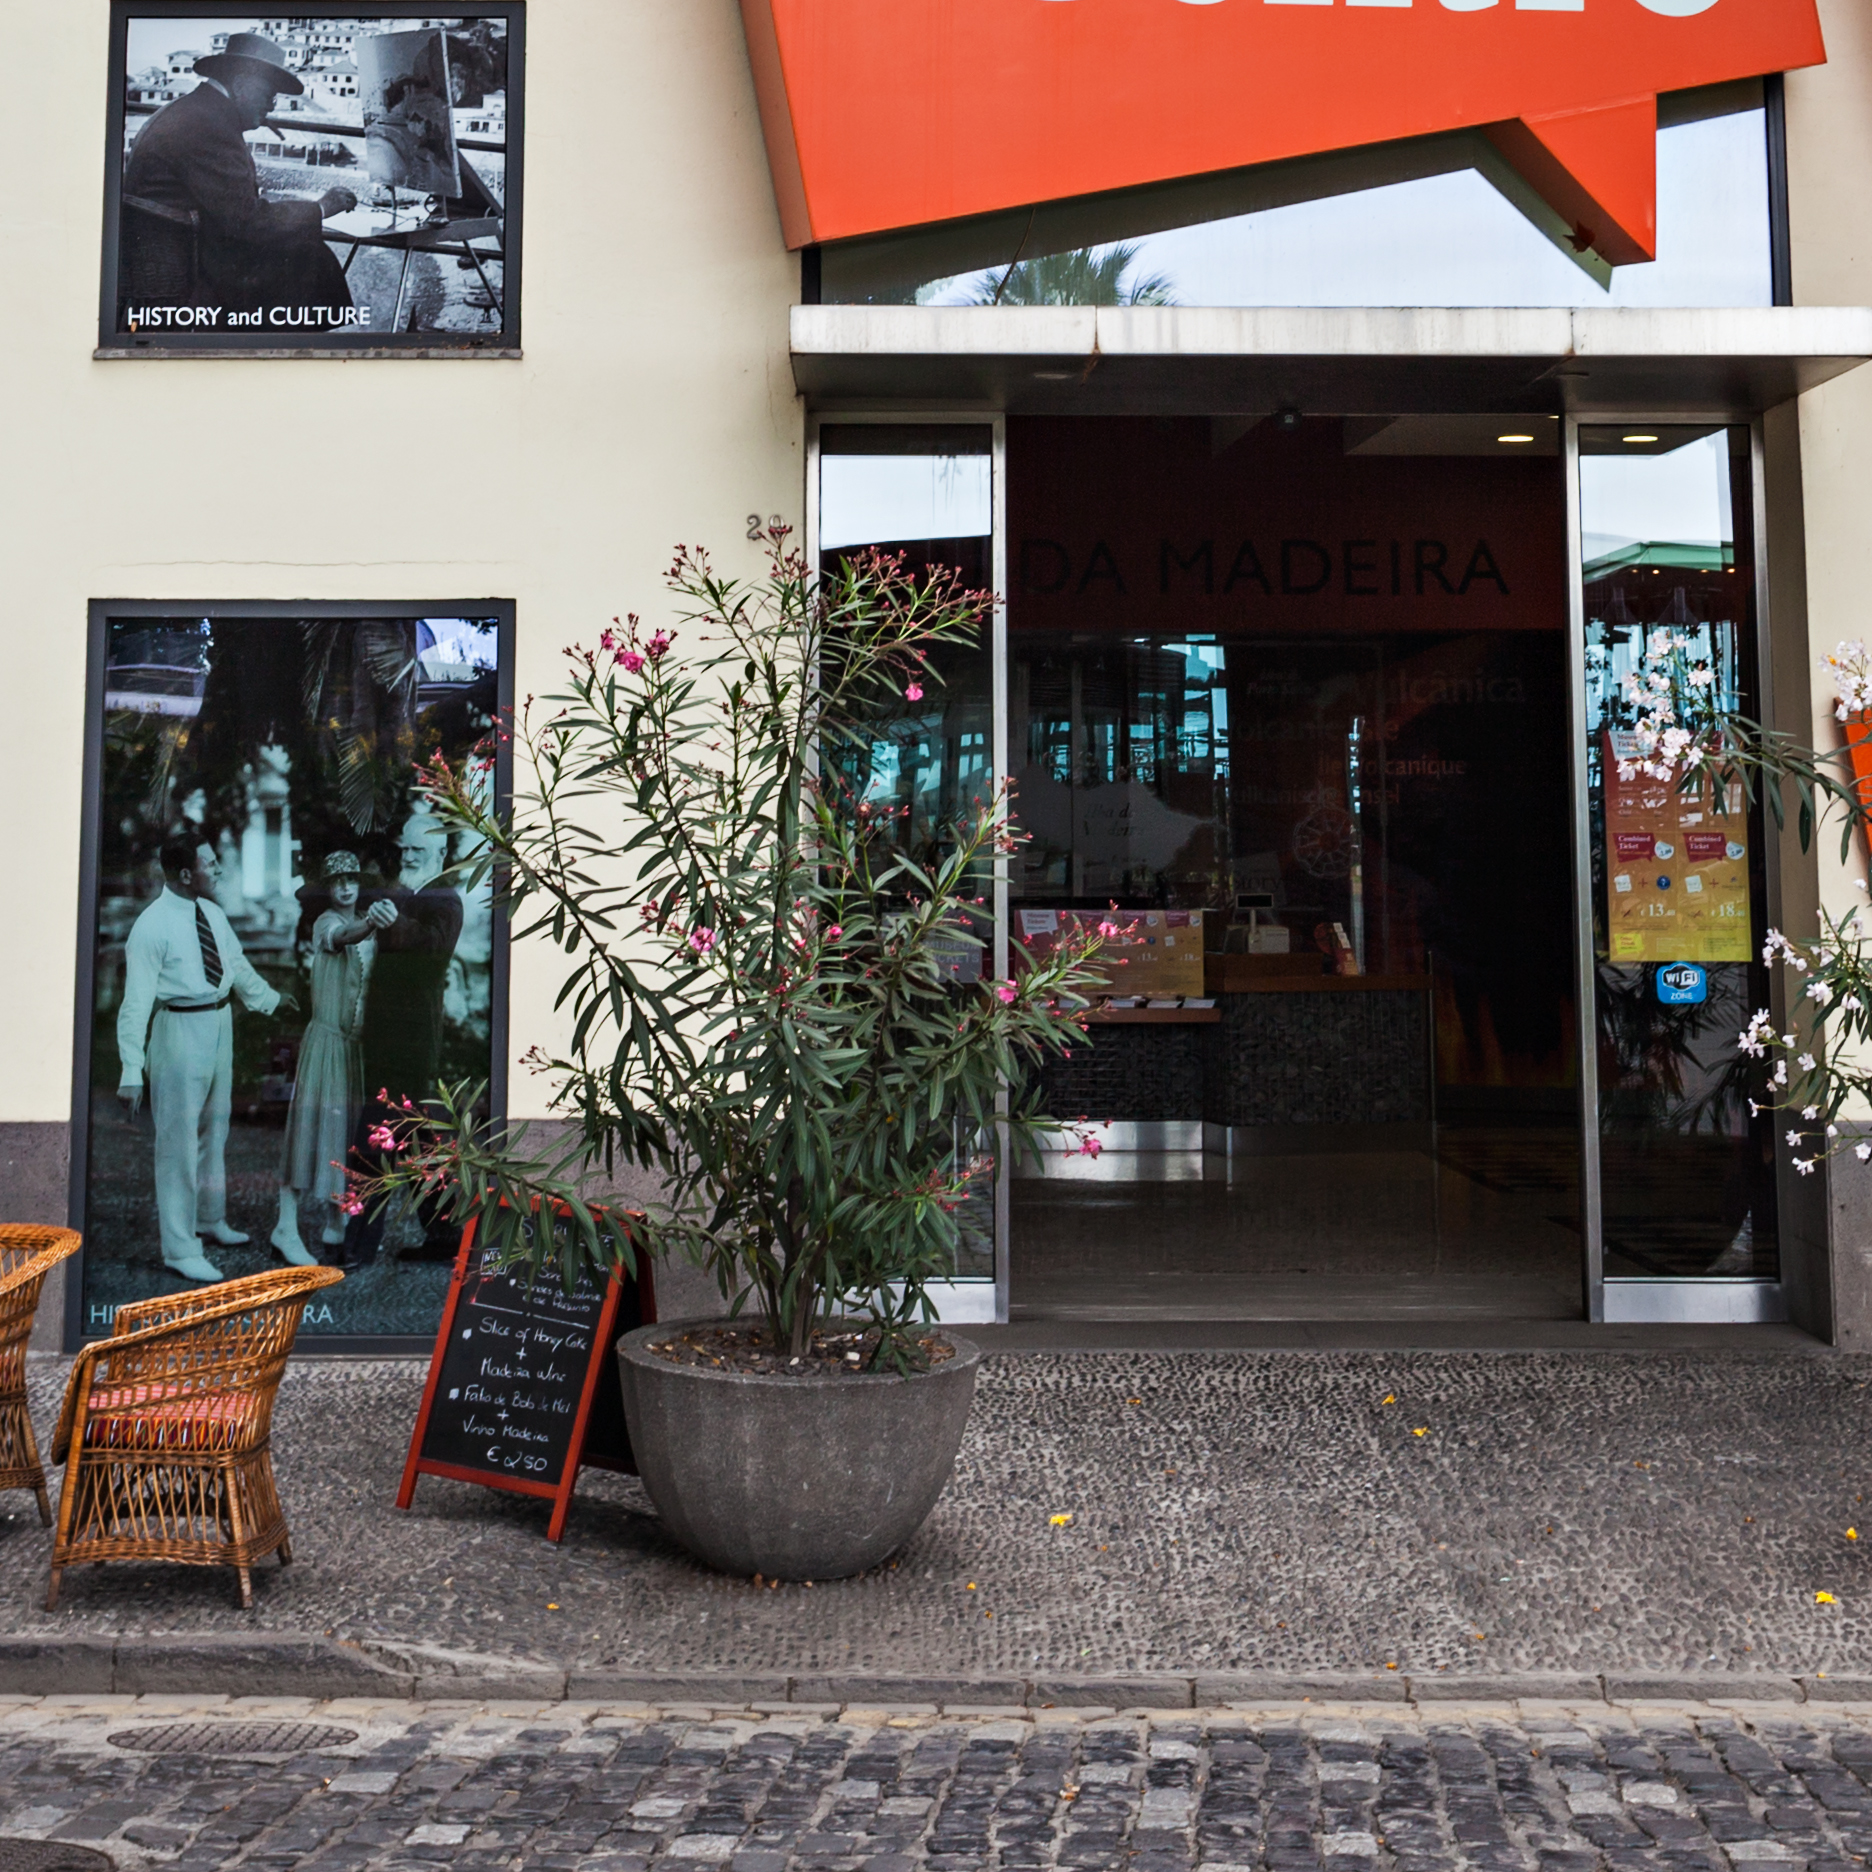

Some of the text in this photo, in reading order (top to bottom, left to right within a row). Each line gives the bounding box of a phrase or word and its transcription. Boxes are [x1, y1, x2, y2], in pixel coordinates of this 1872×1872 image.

[127, 306, 371, 326] HISTORY and CULTURE
[1020, 537, 1511, 596] DA MADEIRA
[1670, 992, 1694, 1001] ZONE
[479, 1317, 587, 1353] Slice of Honey Cake
[480, 1357, 530, 1379] Madeira
[502, 1425, 549, 1442] Madeira
